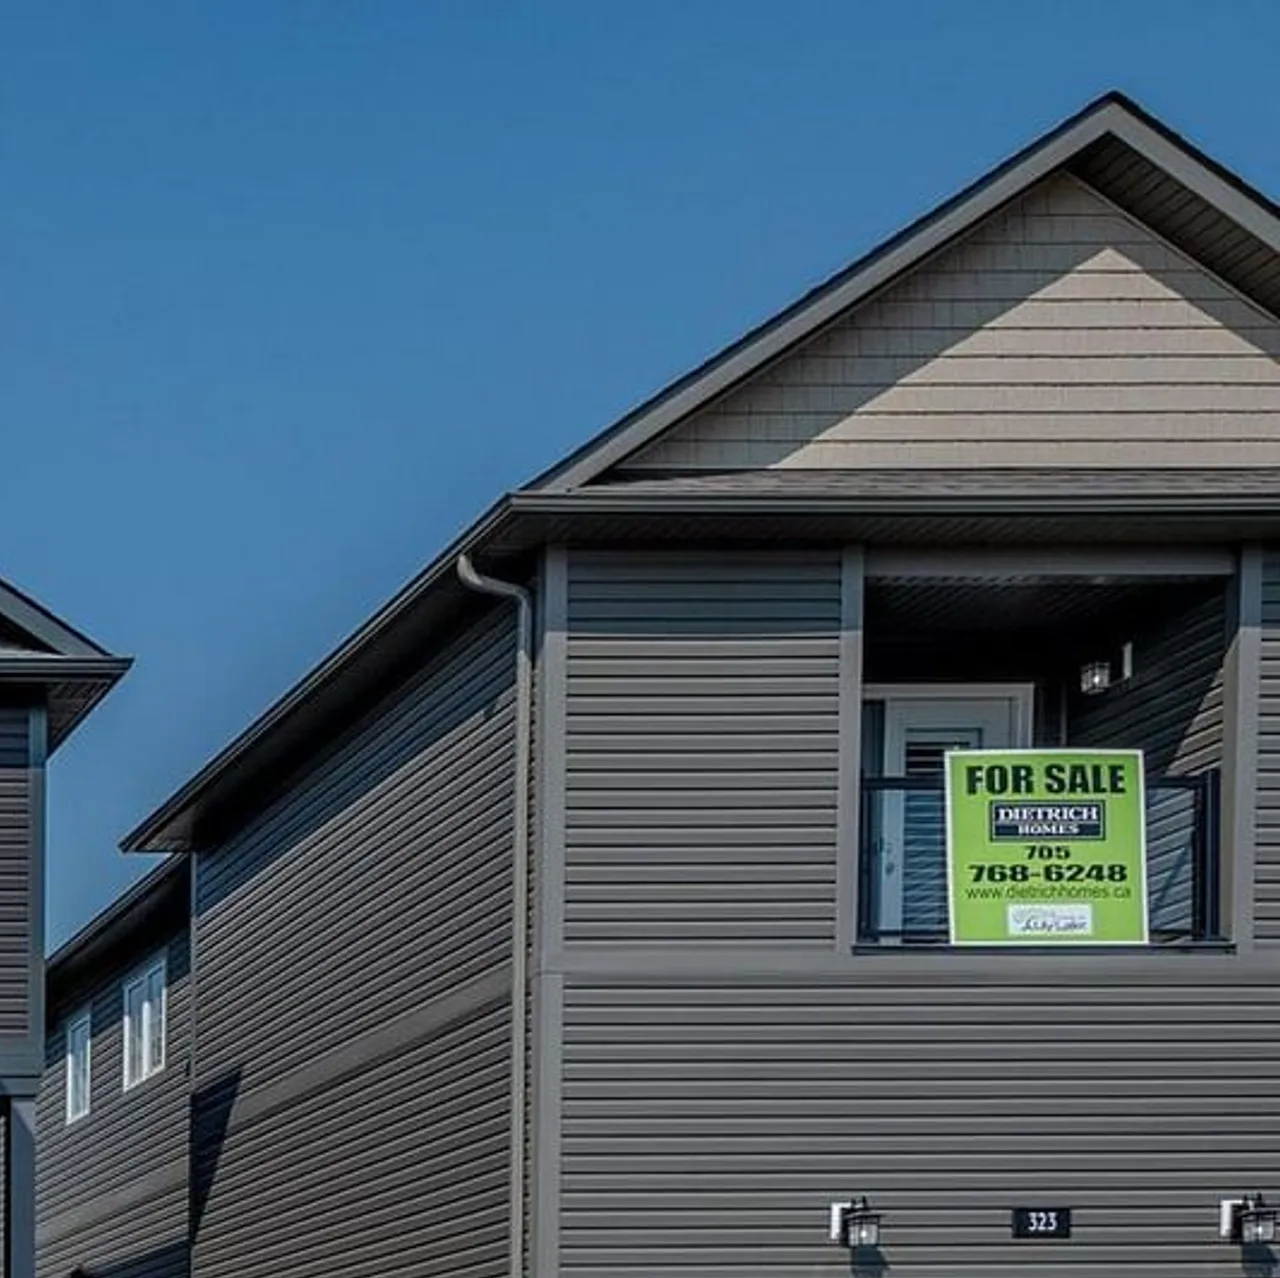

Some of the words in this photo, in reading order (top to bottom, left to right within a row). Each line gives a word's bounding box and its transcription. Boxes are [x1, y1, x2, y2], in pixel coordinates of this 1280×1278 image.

[966, 765, 1034, 795] FOR
[1044, 763, 1127, 794] SALE
[998, 806, 1098, 821] DIETRICH
[1018, 823, 1080, 835] HOMES
[1026, 845, 1071, 860] 705
[968, 864, 1128, 882] 768-6248
[1027, 1211, 1058, 1232] 323
